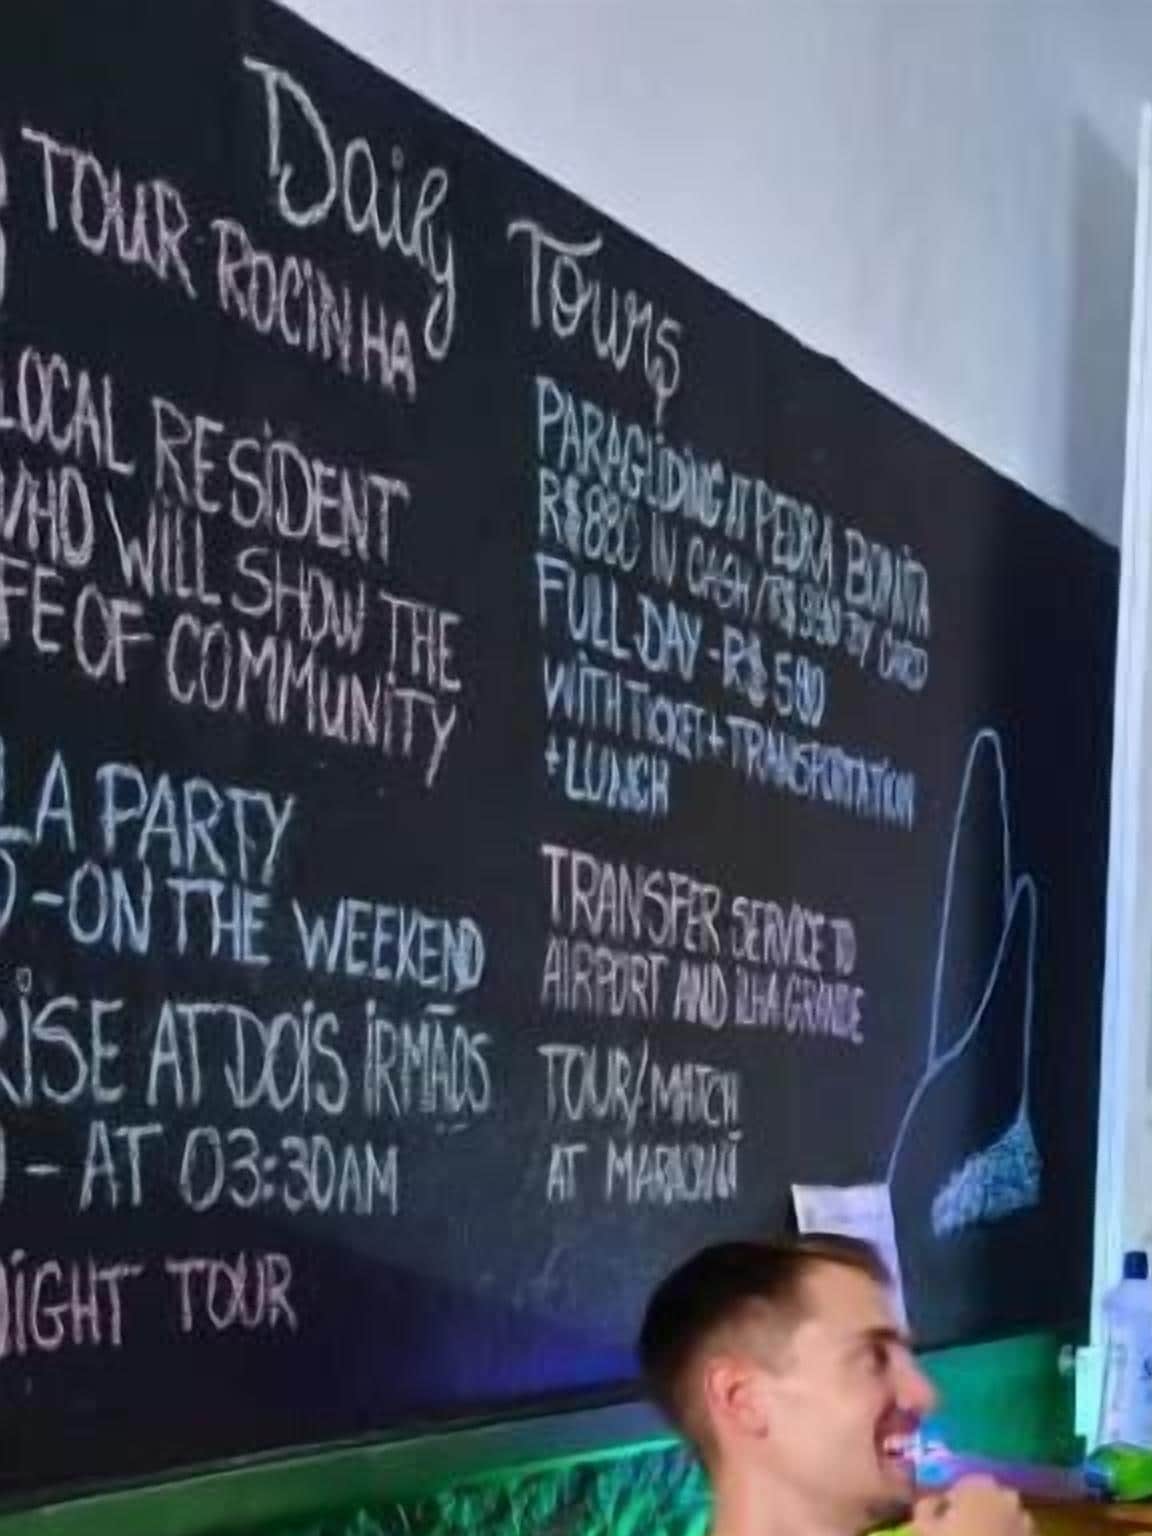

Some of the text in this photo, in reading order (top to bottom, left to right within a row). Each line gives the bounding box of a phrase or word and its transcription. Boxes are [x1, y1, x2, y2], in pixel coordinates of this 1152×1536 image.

[20, 126, 417, 401] TOUR ROCINHA
[507, 218, 683, 424] Tours
[151, 395, 411, 564] RESIDENT
[104, 489, 222, 605] WILL
[231, 545, 366, 657] SHOW
[379, 590, 463, 692] THE
[536, 552, 632, 660] FULL
[633, 594, 704, 684] DAY
[73, 583, 155, 684] OF
[166, 613, 458, 788] COMMUNITY
[95, 762, 296, 883] PARTY
[166, 877, 271, 965] THE
[292, 896, 486, 994] WEEKEND
[540, 842, 722, 958] TRANSFER
[541, 935, 670, 1019] AIRPORT
[147, 999, 221, 1107] AT
[223, 998, 350, 1115] DOIS
[79, 1119, 164, 1214] AT
[546, 1142, 589, 1202] AT
[166, 1251, 299, 1335] TOUR
